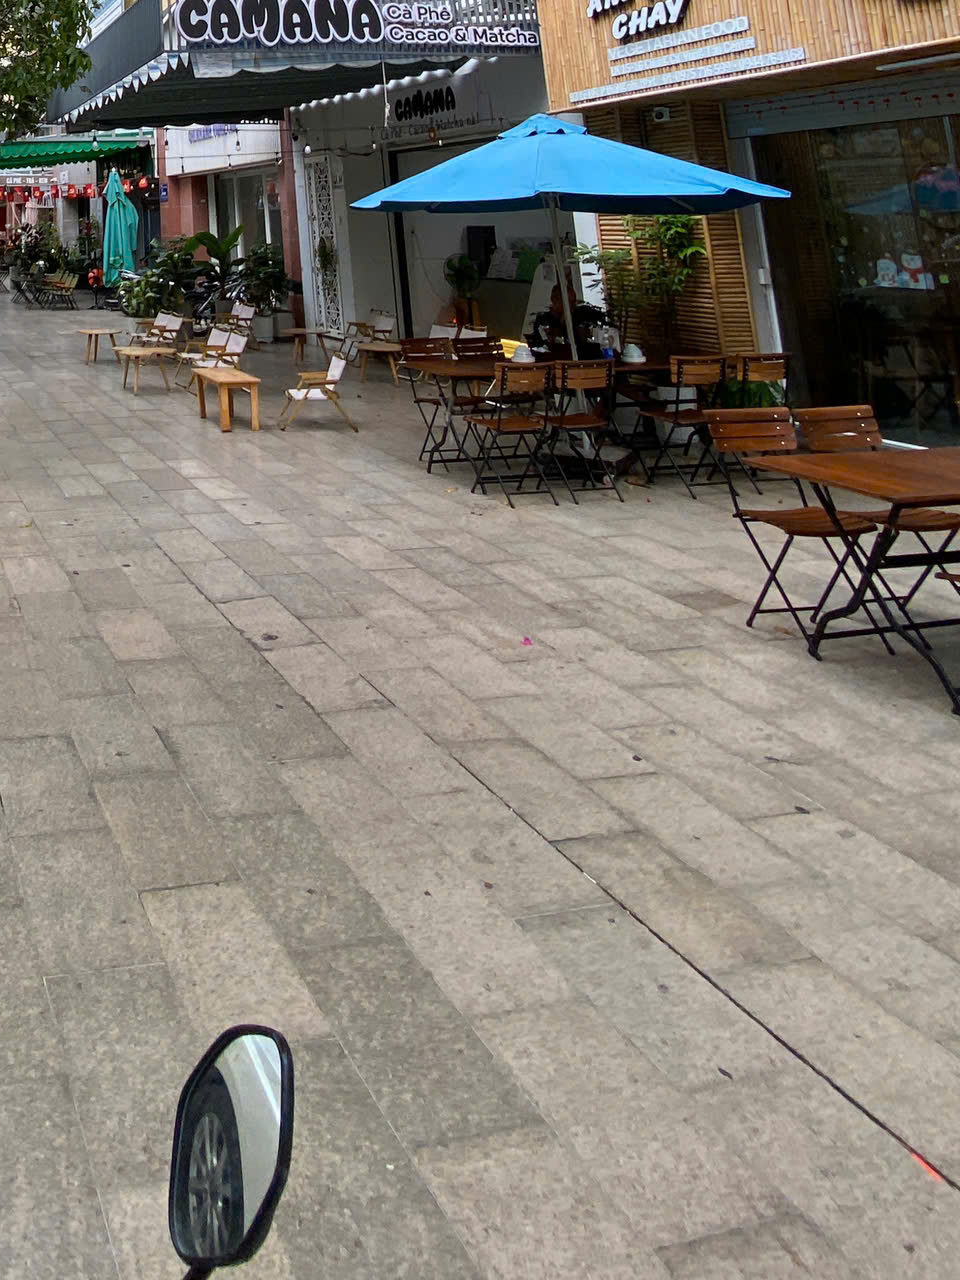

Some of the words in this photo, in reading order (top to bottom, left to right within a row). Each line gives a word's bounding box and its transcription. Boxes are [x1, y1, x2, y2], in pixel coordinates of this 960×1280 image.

[386, 5, 413, 20] Cà
[417, 5, 451, 21] Phê
[389, 26, 449, 42] Cacao
[454, 27, 468, 42] &
[473, 27, 538, 44] Matcha
[702, 16, 749, 38] FOOD
